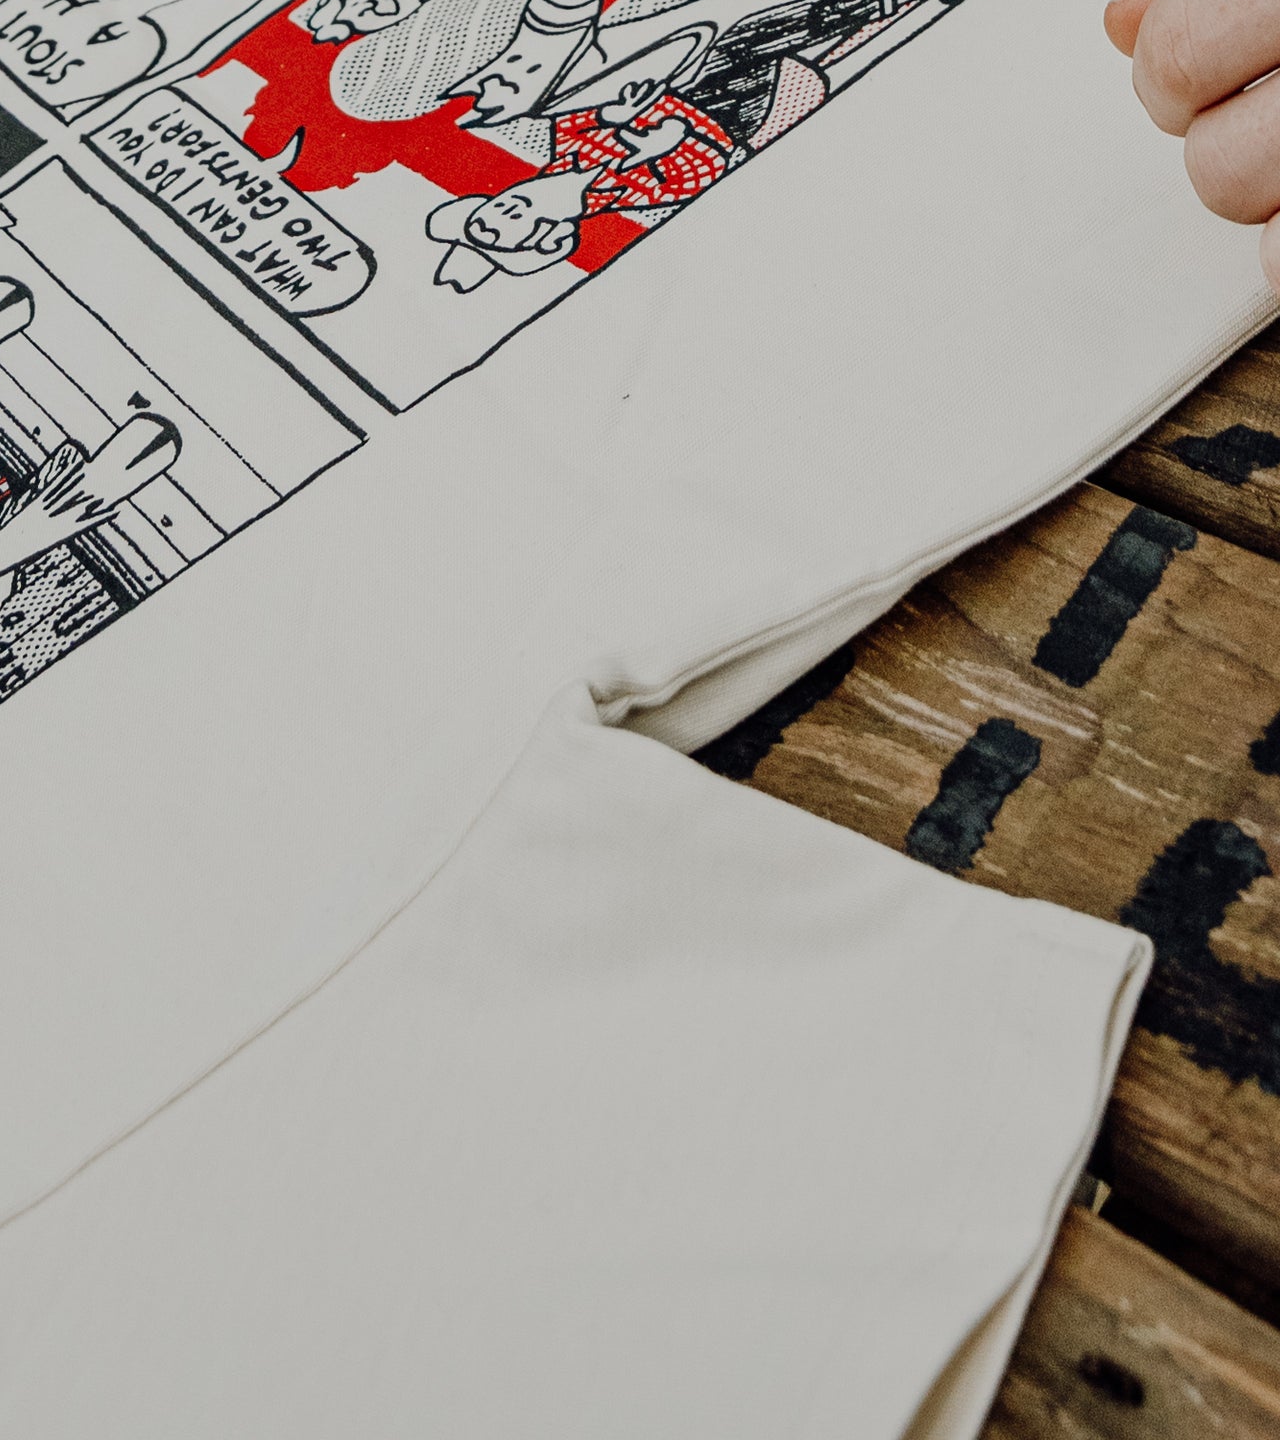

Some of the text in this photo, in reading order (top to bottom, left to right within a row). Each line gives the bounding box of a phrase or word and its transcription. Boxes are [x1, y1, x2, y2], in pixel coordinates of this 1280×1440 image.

[86, 20, 130, 46] A
[108, 127, 313, 302] WHAT CAN I DO YOU
[282, 218, 351, 271] TWO
